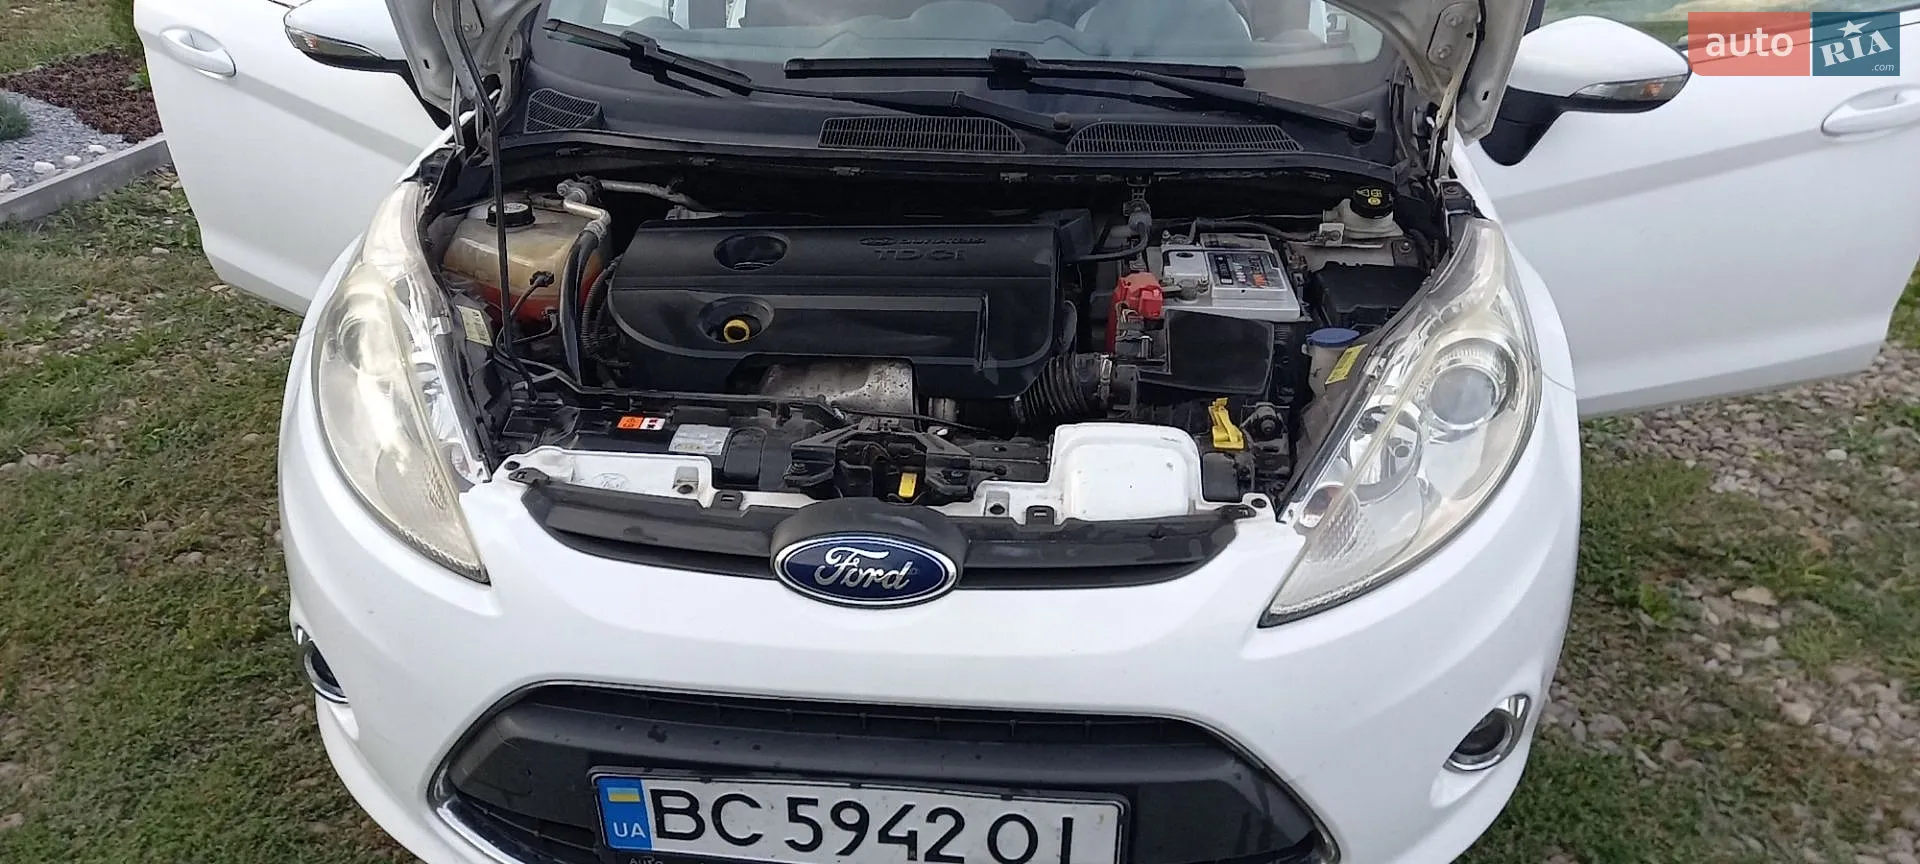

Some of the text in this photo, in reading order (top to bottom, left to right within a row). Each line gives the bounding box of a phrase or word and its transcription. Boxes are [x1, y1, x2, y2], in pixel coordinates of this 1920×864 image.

[814, 546, 913, 590] Ford
[613, 822, 646, 838] UA
[649, 789, 763, 847] BC
[784, 797, 965, 864] 5942
